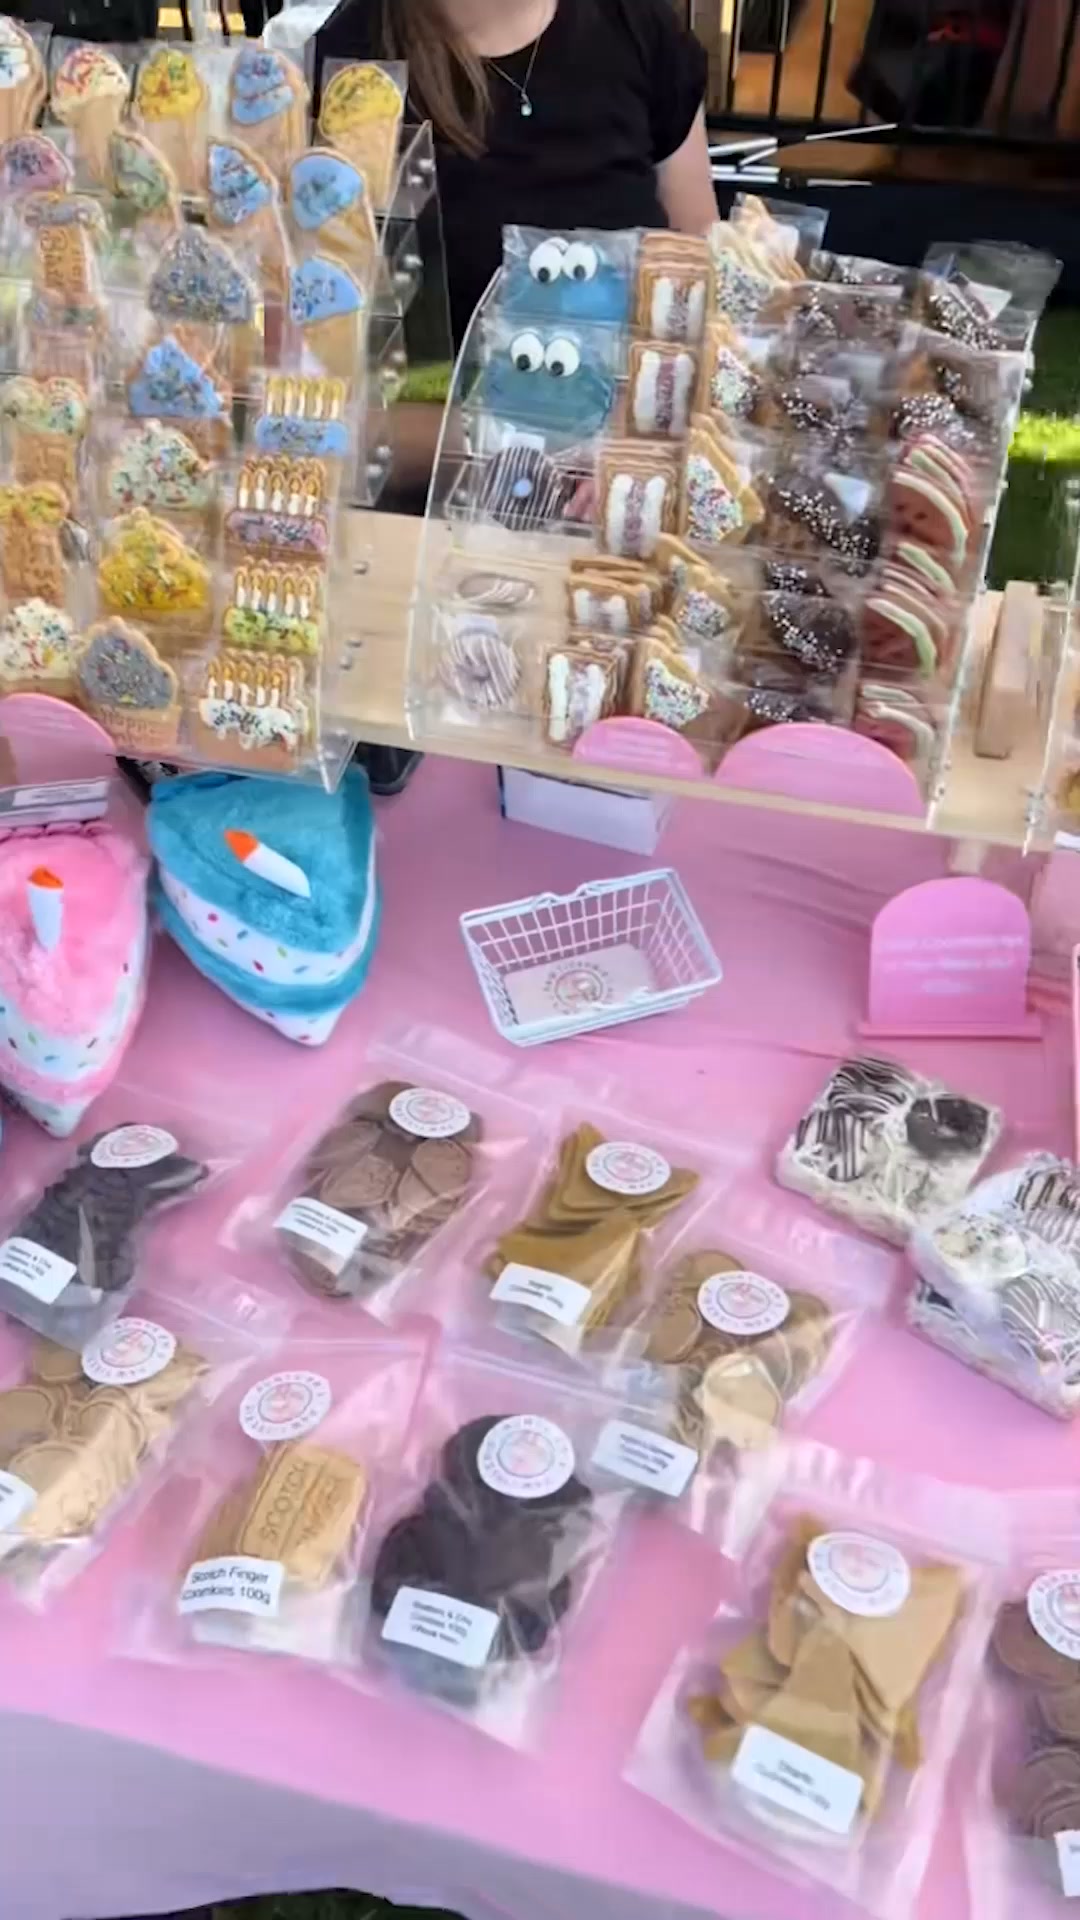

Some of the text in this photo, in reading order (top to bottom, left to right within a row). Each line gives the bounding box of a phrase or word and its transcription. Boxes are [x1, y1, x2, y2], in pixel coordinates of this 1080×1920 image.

[191, 1566, 269, 1585] Scotch Finger
[240, 1585, 271, 1605] 100g
